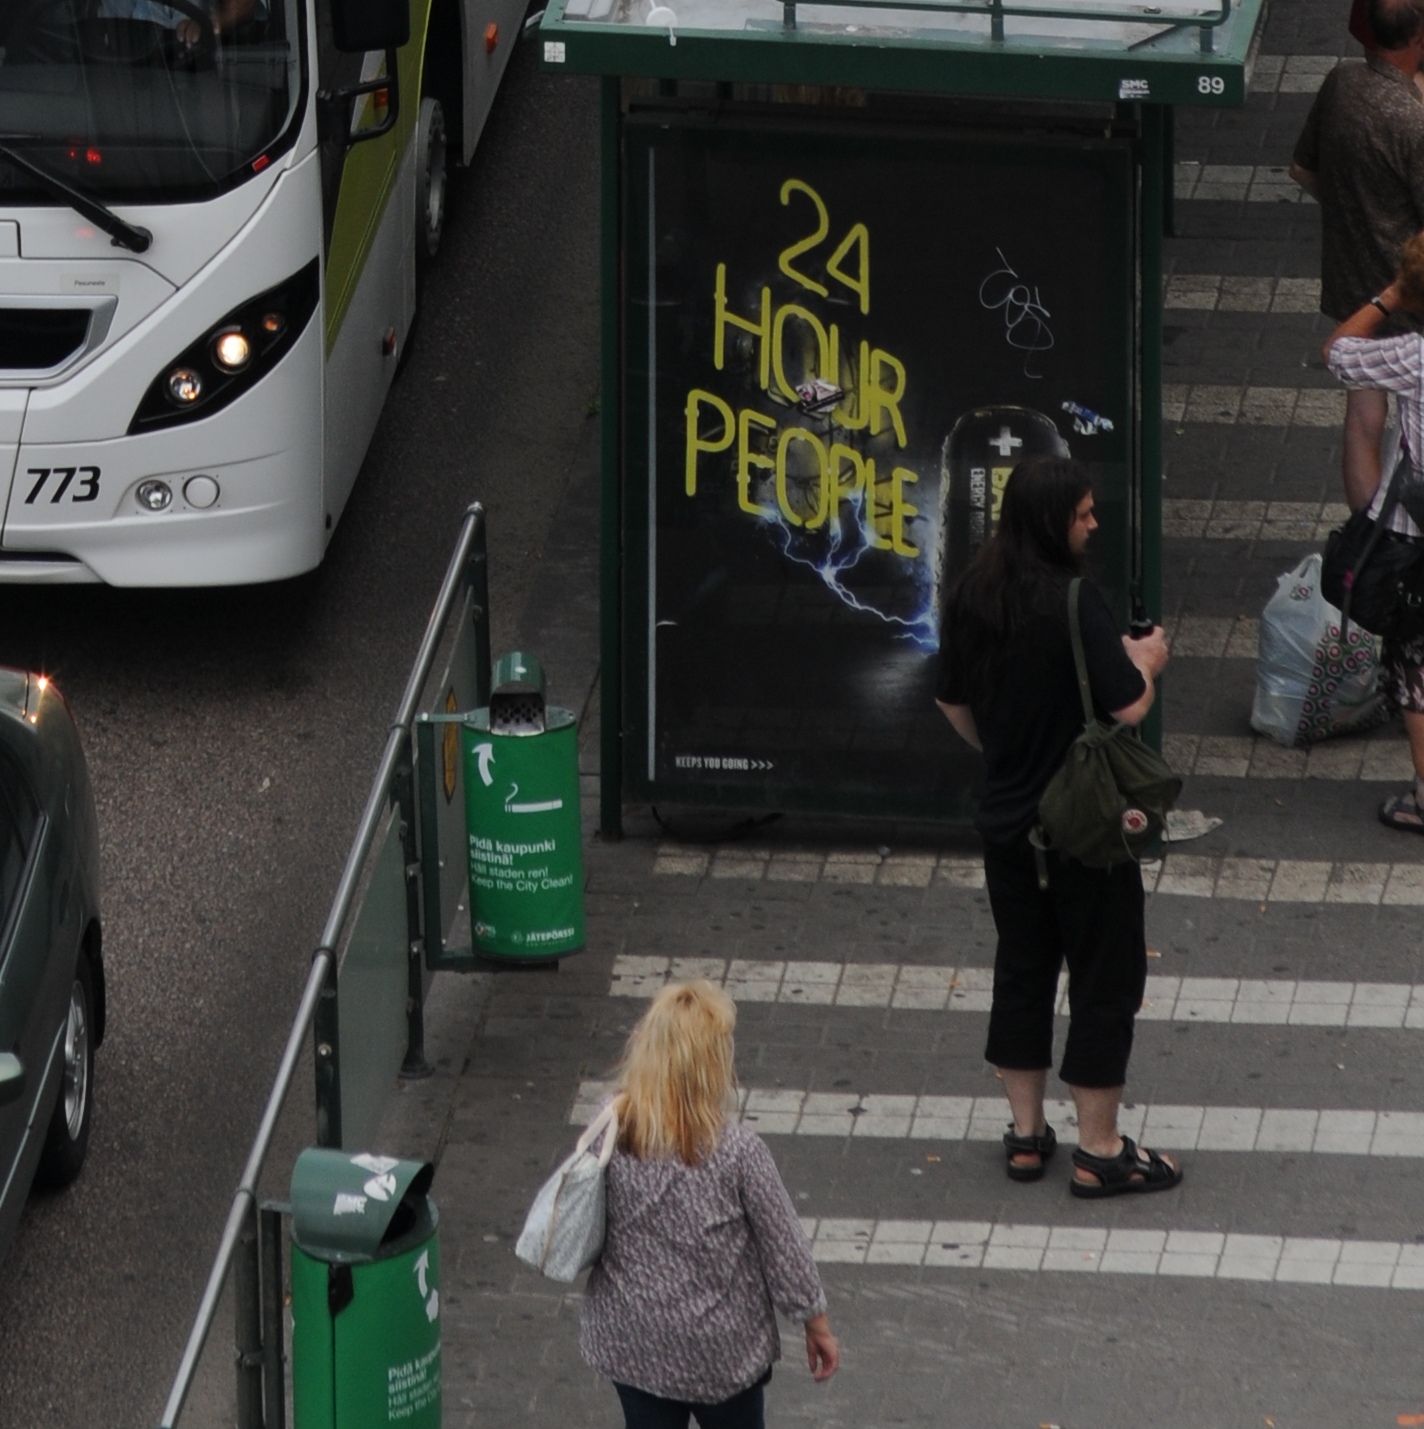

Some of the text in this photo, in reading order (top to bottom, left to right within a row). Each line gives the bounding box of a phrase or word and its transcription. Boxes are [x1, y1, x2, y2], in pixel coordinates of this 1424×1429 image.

[1198, 76, 1225, 95] 89
[780, 178, 870, 315] 24
[714, 262, 907, 448] HOUR
[685, 389, 919, 557] PEOPLE
[24, 465, 102, 504] 773
[676, 756, 749, 771] KEEPS YOU GOING
[469, 834, 556, 857] Pidä kaupunki
[470, 848, 514, 866] siistinä!
[489, 867, 525, 879] staden
[528, 866, 549, 878] ren!
[471, 874, 574, 893] Keep the City Clean!
